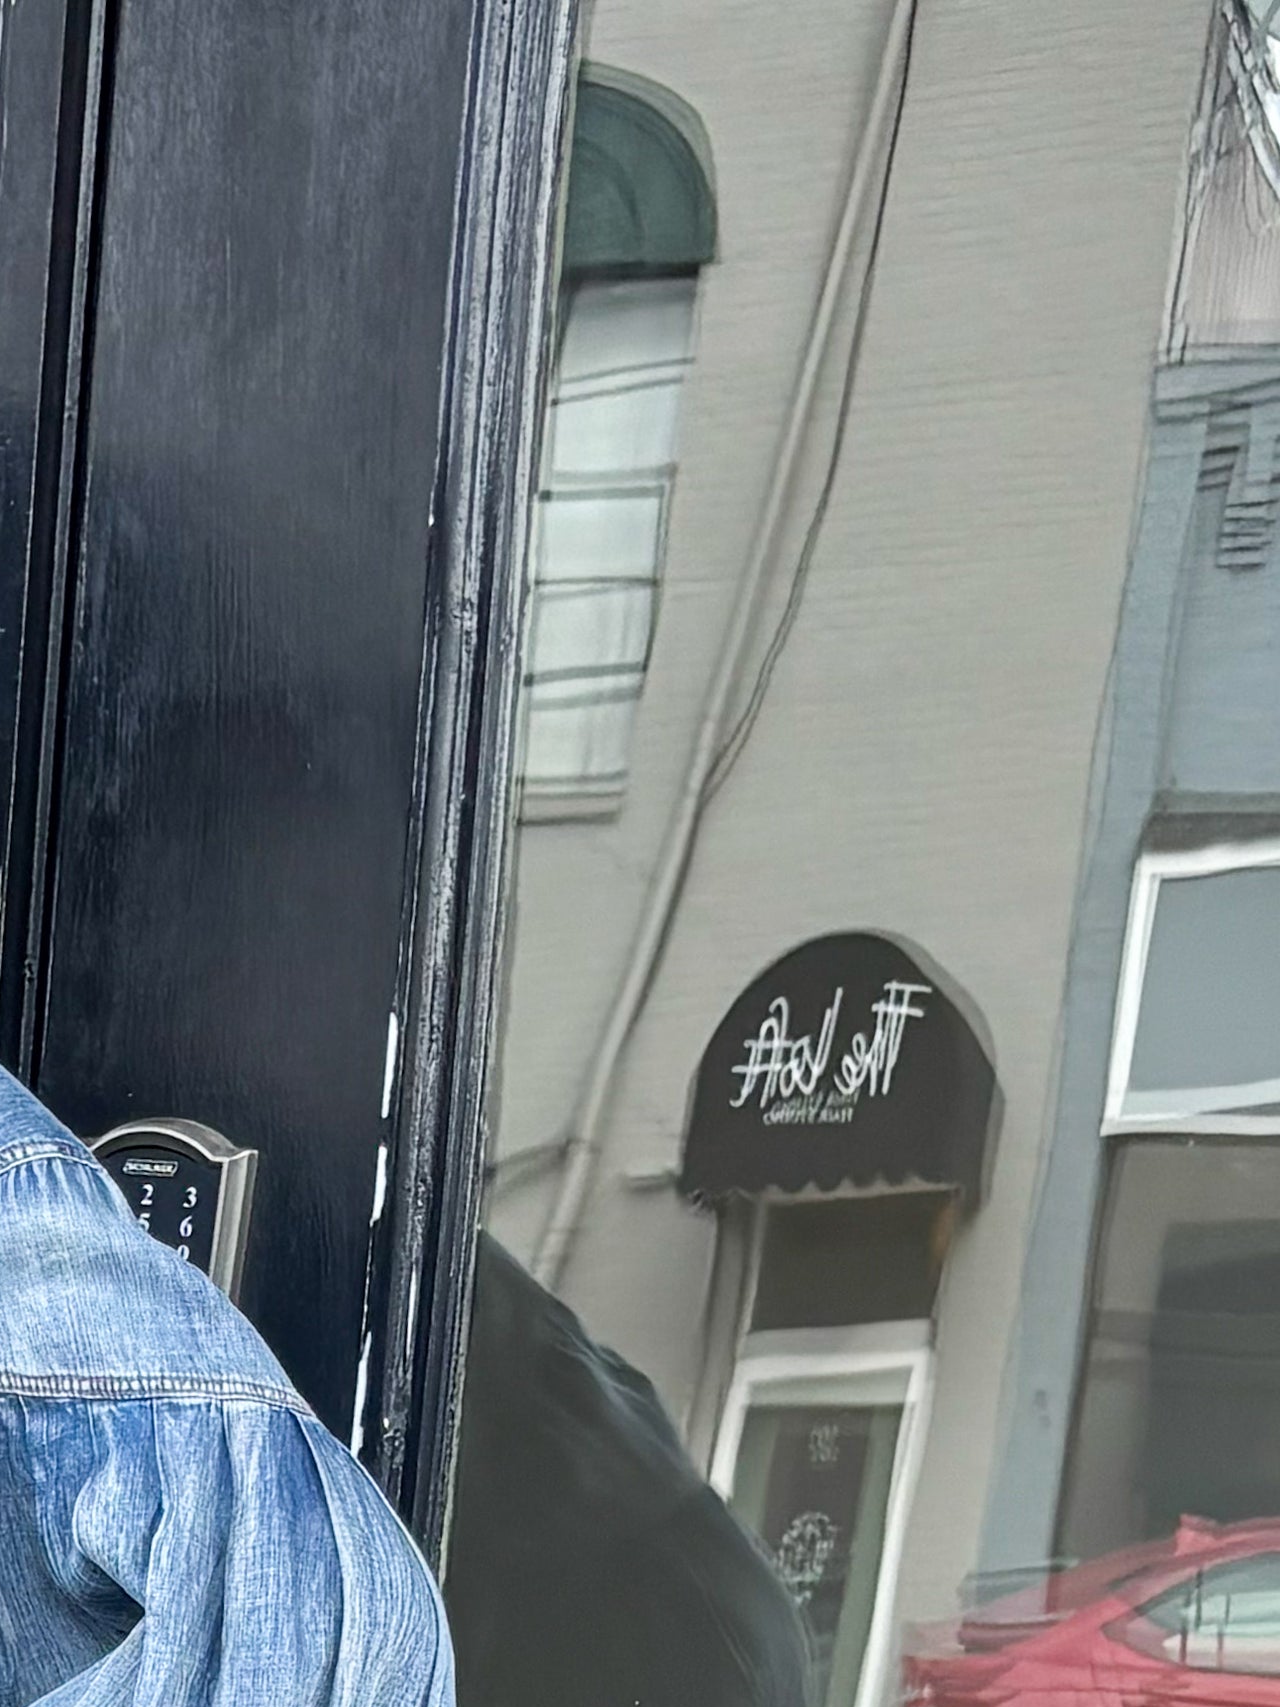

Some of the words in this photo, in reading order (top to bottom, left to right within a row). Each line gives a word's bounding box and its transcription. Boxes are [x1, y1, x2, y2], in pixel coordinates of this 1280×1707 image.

[140, 1184, 154, 1205] 2
[182, 1186, 197, 1208] 3
[179, 1215, 192, 1237] 6
